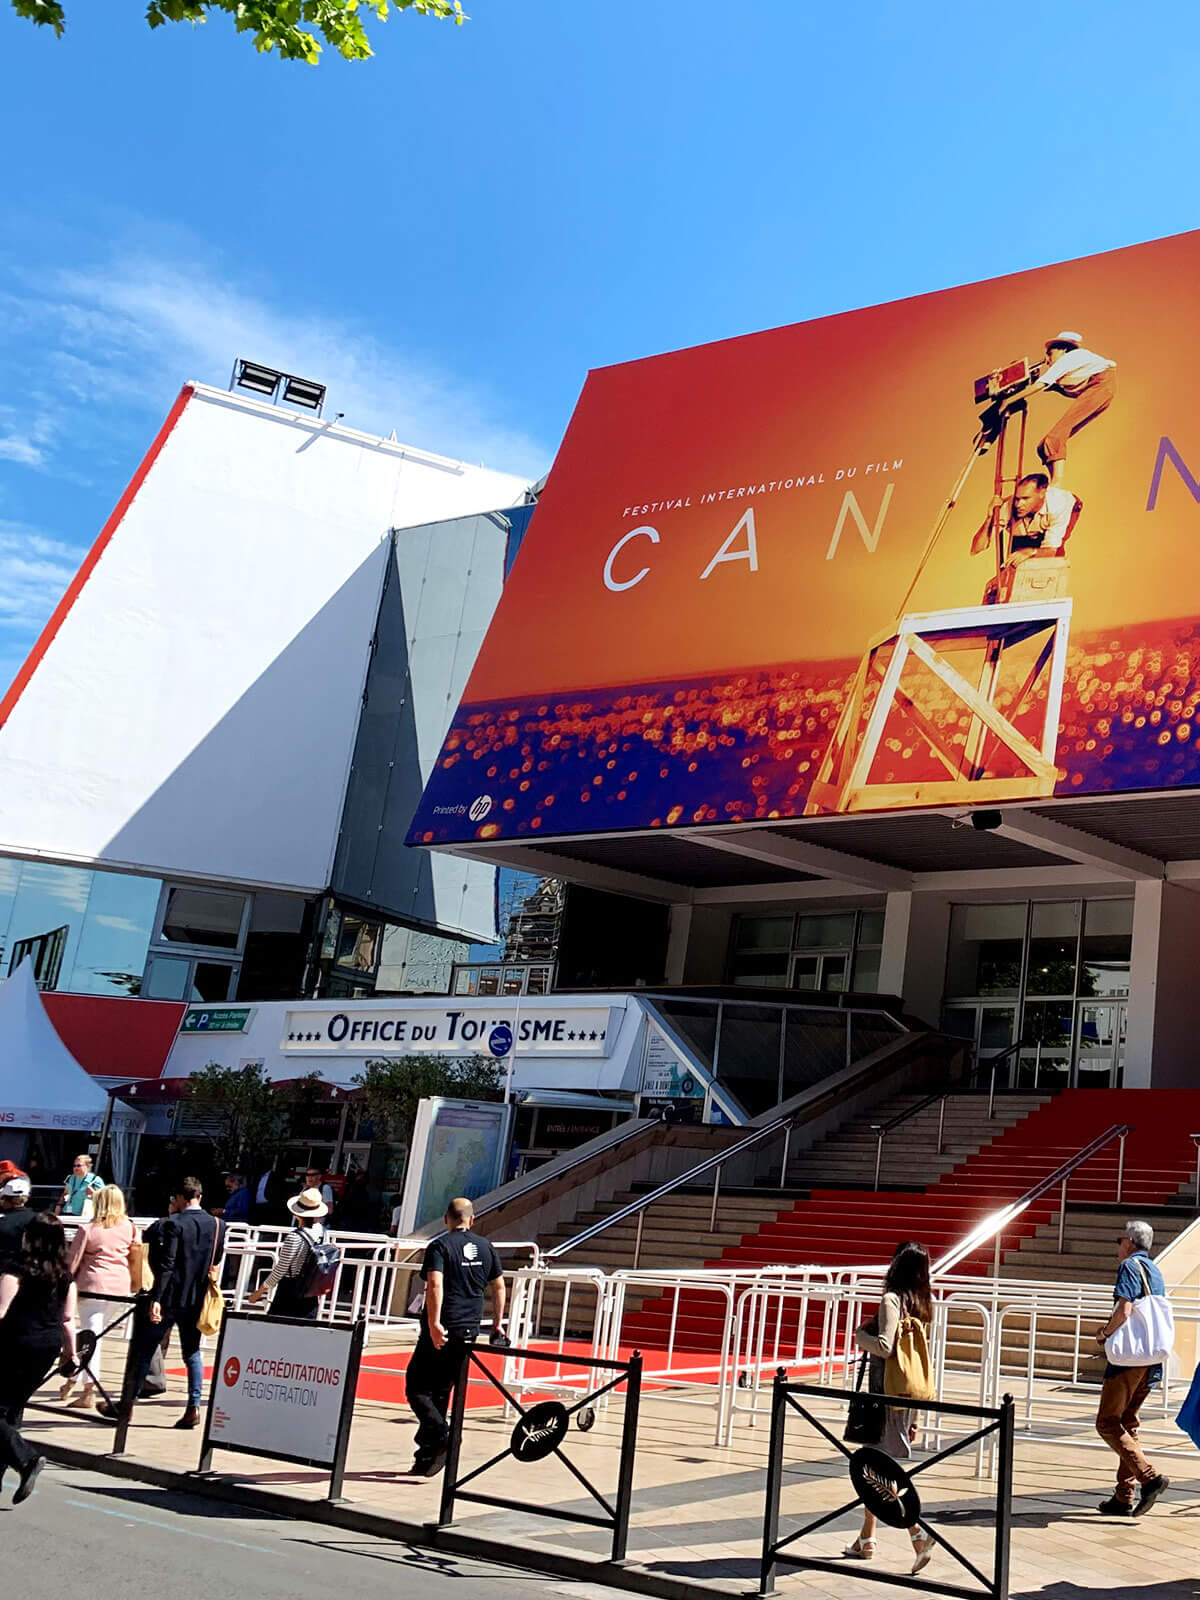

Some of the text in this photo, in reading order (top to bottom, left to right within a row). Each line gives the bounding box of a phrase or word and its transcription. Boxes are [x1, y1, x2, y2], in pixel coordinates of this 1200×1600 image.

[622, 459, 904, 518] FESTIVAL INTERNATIONAL DU FILM
[469, 795, 492, 821] hp
[327, 1011, 567, 1042] OFFICE DU TOSME
[52, 1114, 141, 1128] REGISTTION
[246, 1357, 341, 1386] ACCRÉDITATIONS
[241, 1380, 319, 1407] REGISTRATION
